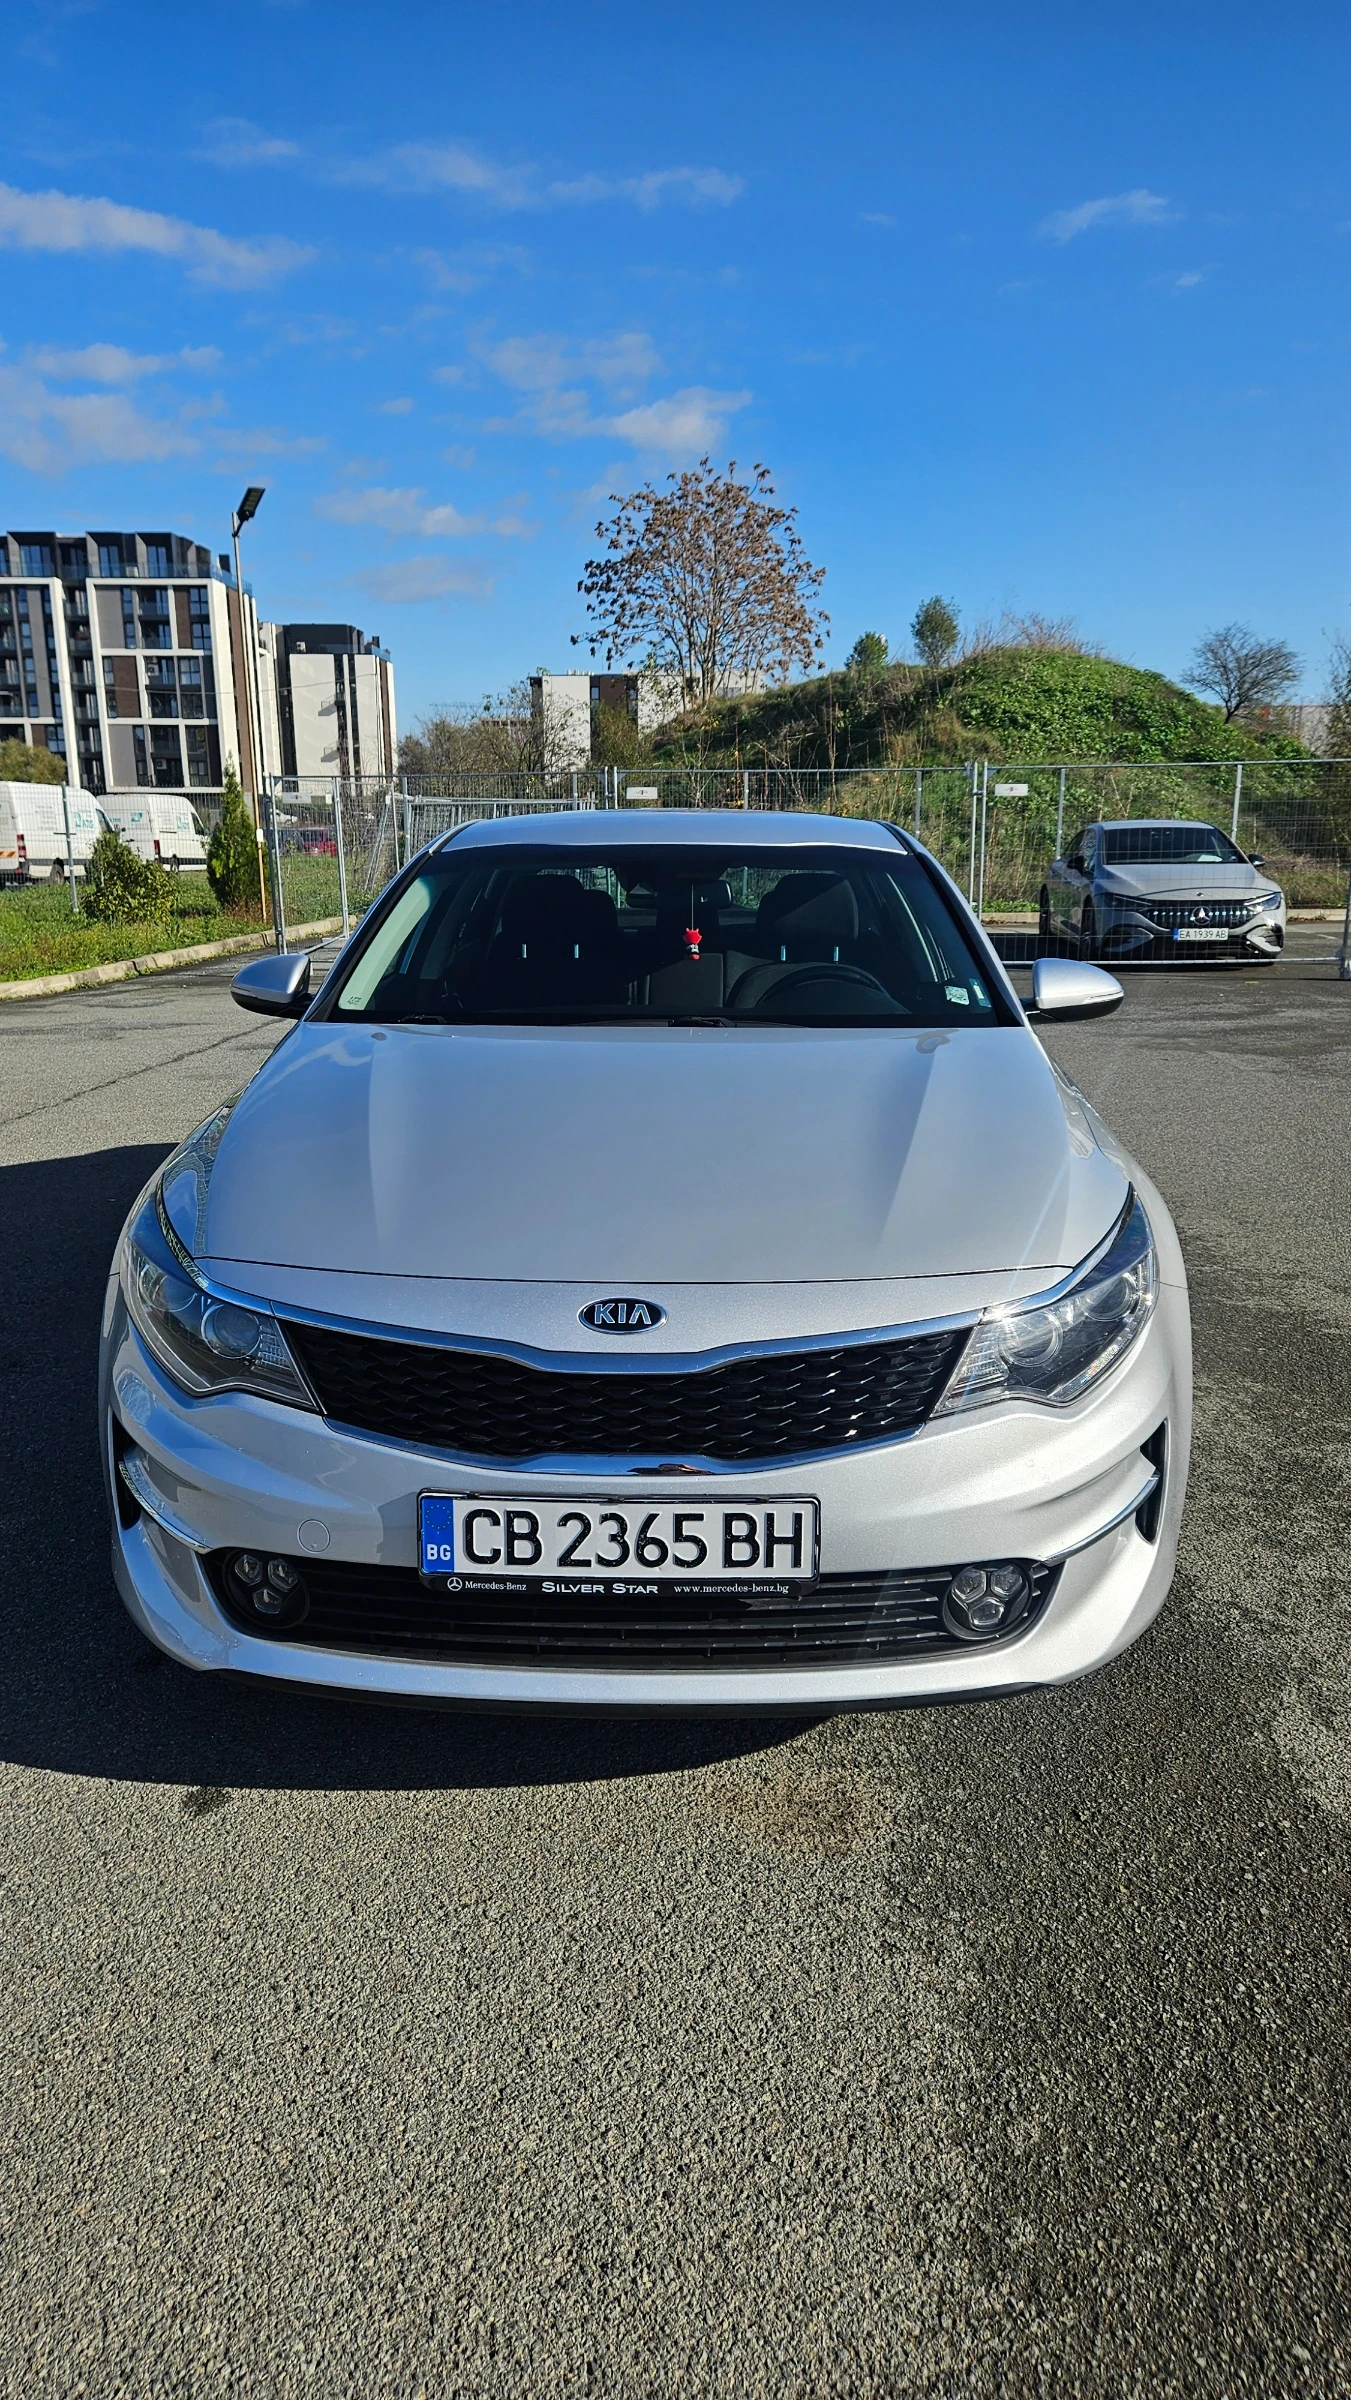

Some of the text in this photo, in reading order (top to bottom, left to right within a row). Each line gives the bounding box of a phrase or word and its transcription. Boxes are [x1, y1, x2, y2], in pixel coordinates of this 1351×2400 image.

[1180, 930, 1226, 938] EA 1939 AB
[594, 1303, 652, 1324] KIA
[463, 1508, 803, 1569] CB 2365 BH
[426, 1543, 451, 1561] BG
[464, 1580, 790, 1595] Mercedes-Benz SILVER STAR www.mercedes-benz.bg
